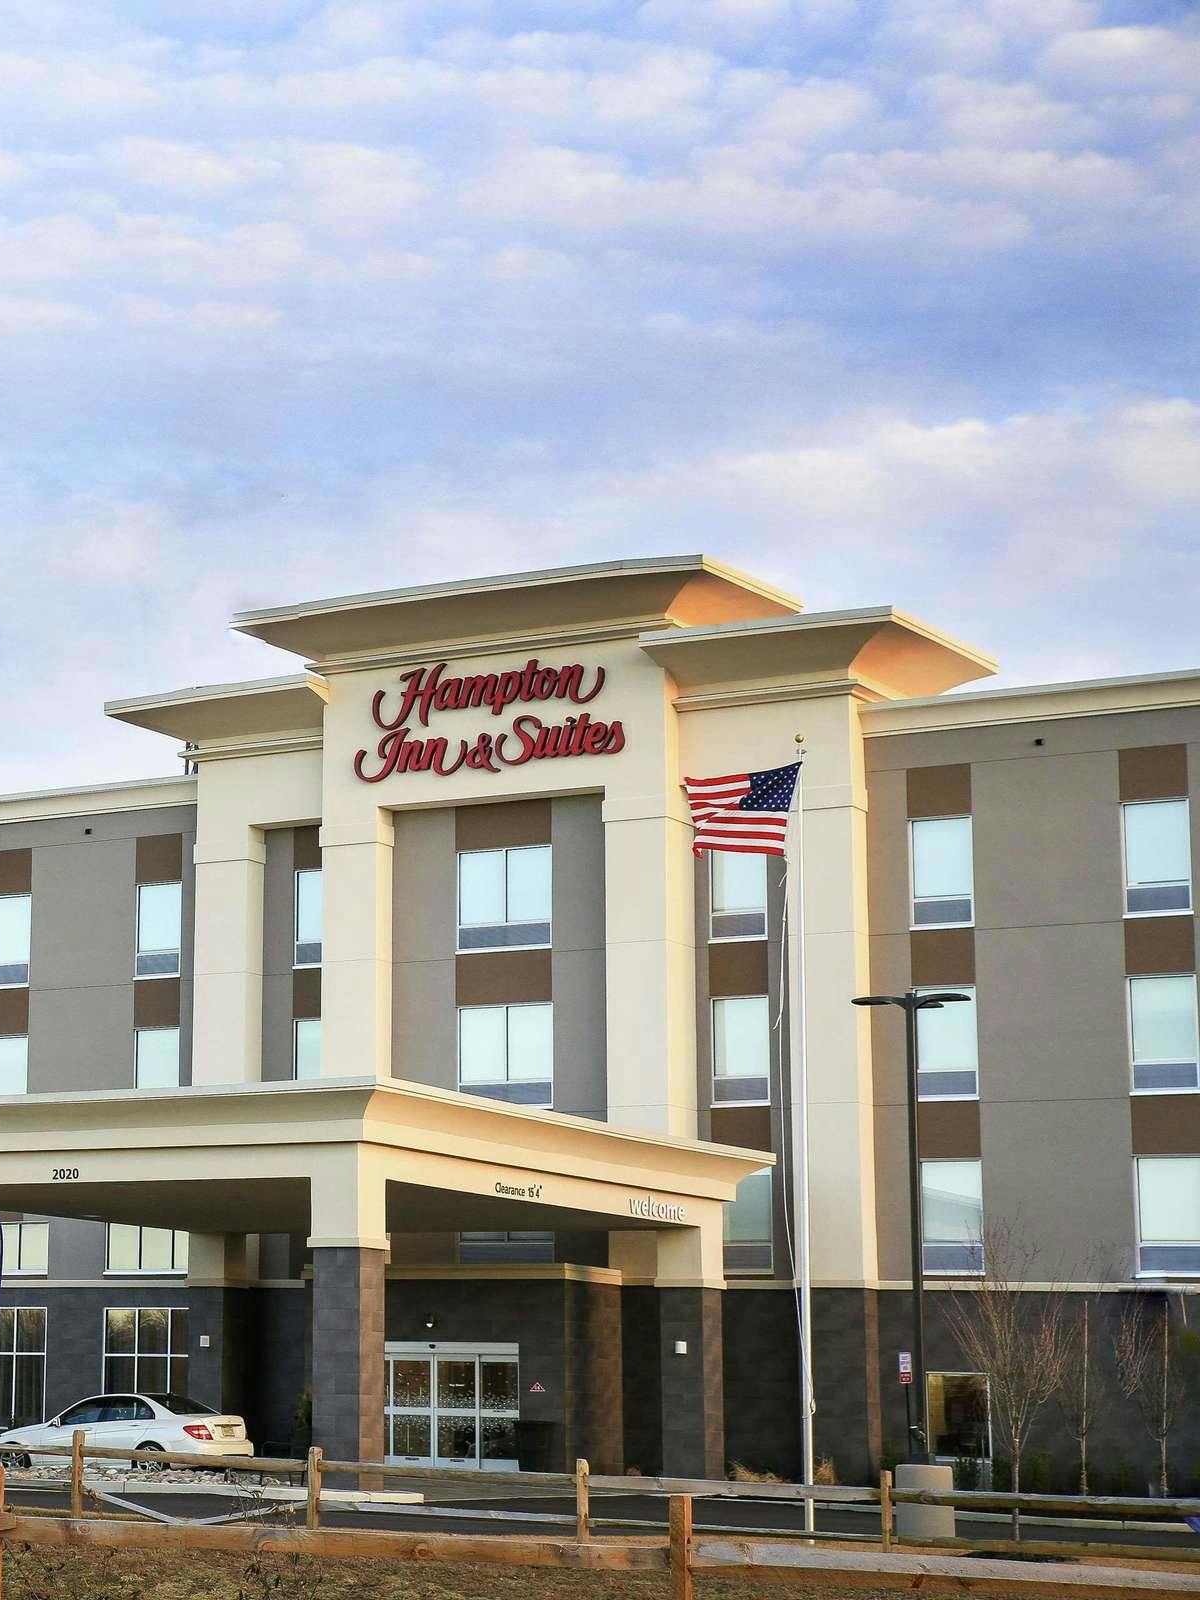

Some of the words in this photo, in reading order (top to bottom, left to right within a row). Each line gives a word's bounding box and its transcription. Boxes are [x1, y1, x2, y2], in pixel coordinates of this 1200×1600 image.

[372, 659, 605, 731] Hampton
[354, 727, 467, 783] Inn
[465, 732, 501, 773] &
[495, 712, 626, 766] Suites
[52, 1168, 79, 1180] 2020
[495, 1182, 526, 1197] Clearance
[628, 1194, 686, 1222] welcome
